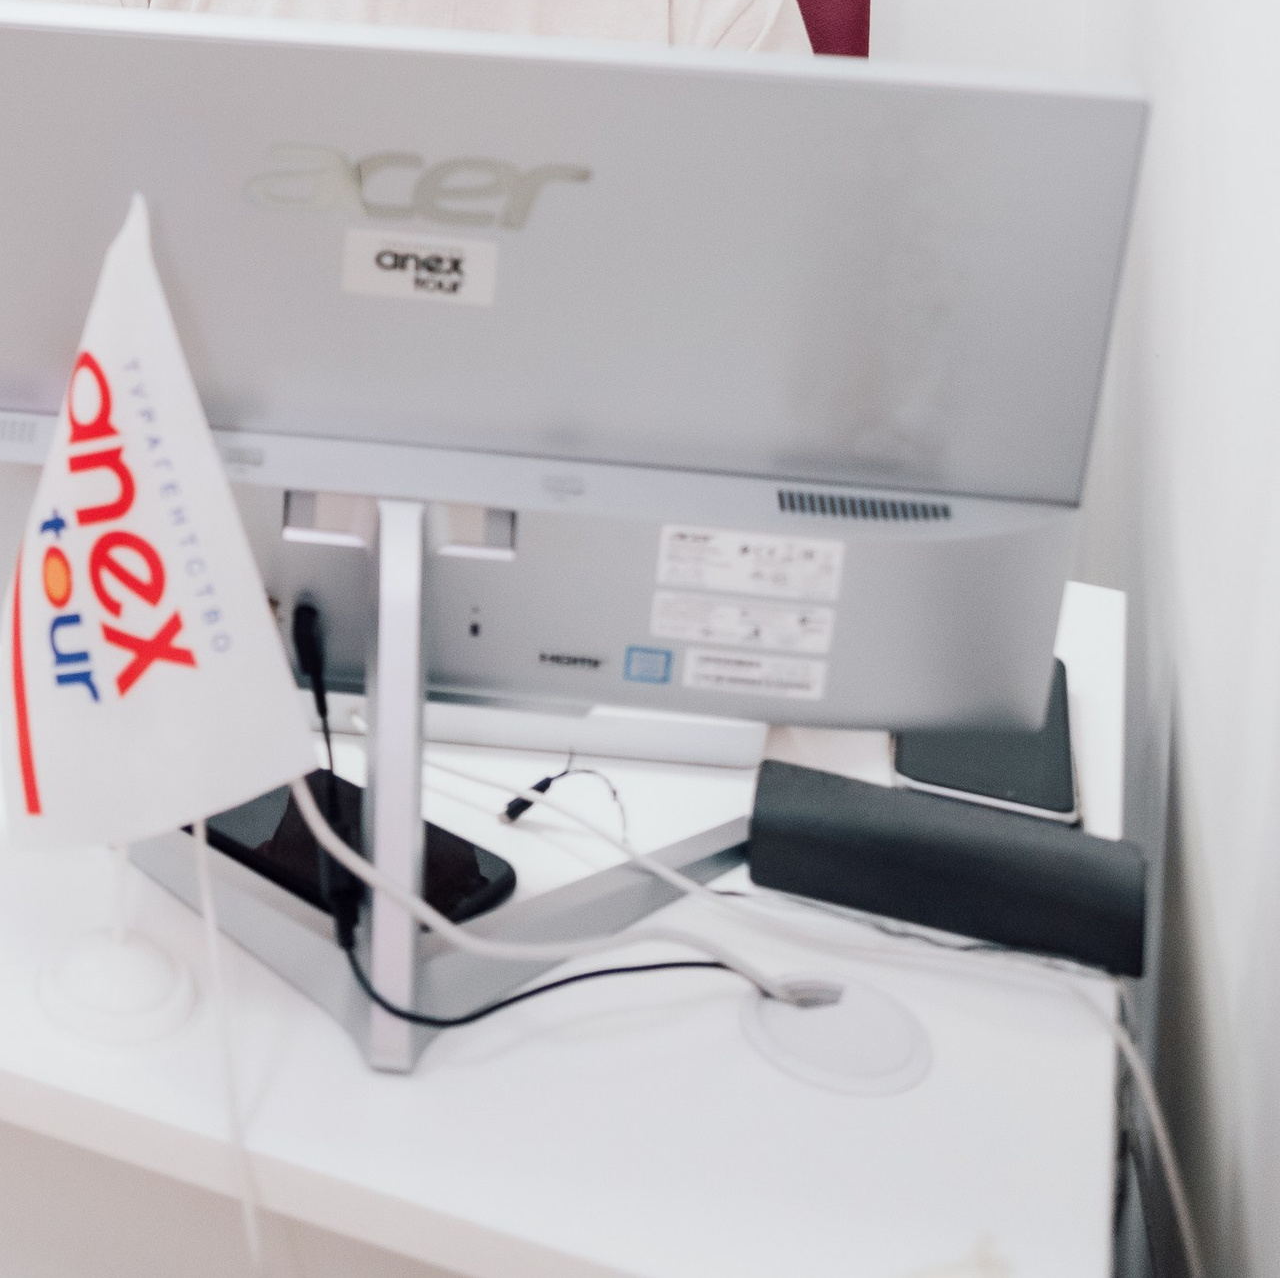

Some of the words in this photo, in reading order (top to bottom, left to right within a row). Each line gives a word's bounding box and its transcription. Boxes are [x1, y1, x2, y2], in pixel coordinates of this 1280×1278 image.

[242, 142, 593, 229] acer
[375, 249, 464, 276] anex
[67, 351, 199, 698] anex
[40, 509, 102, 704] tour
